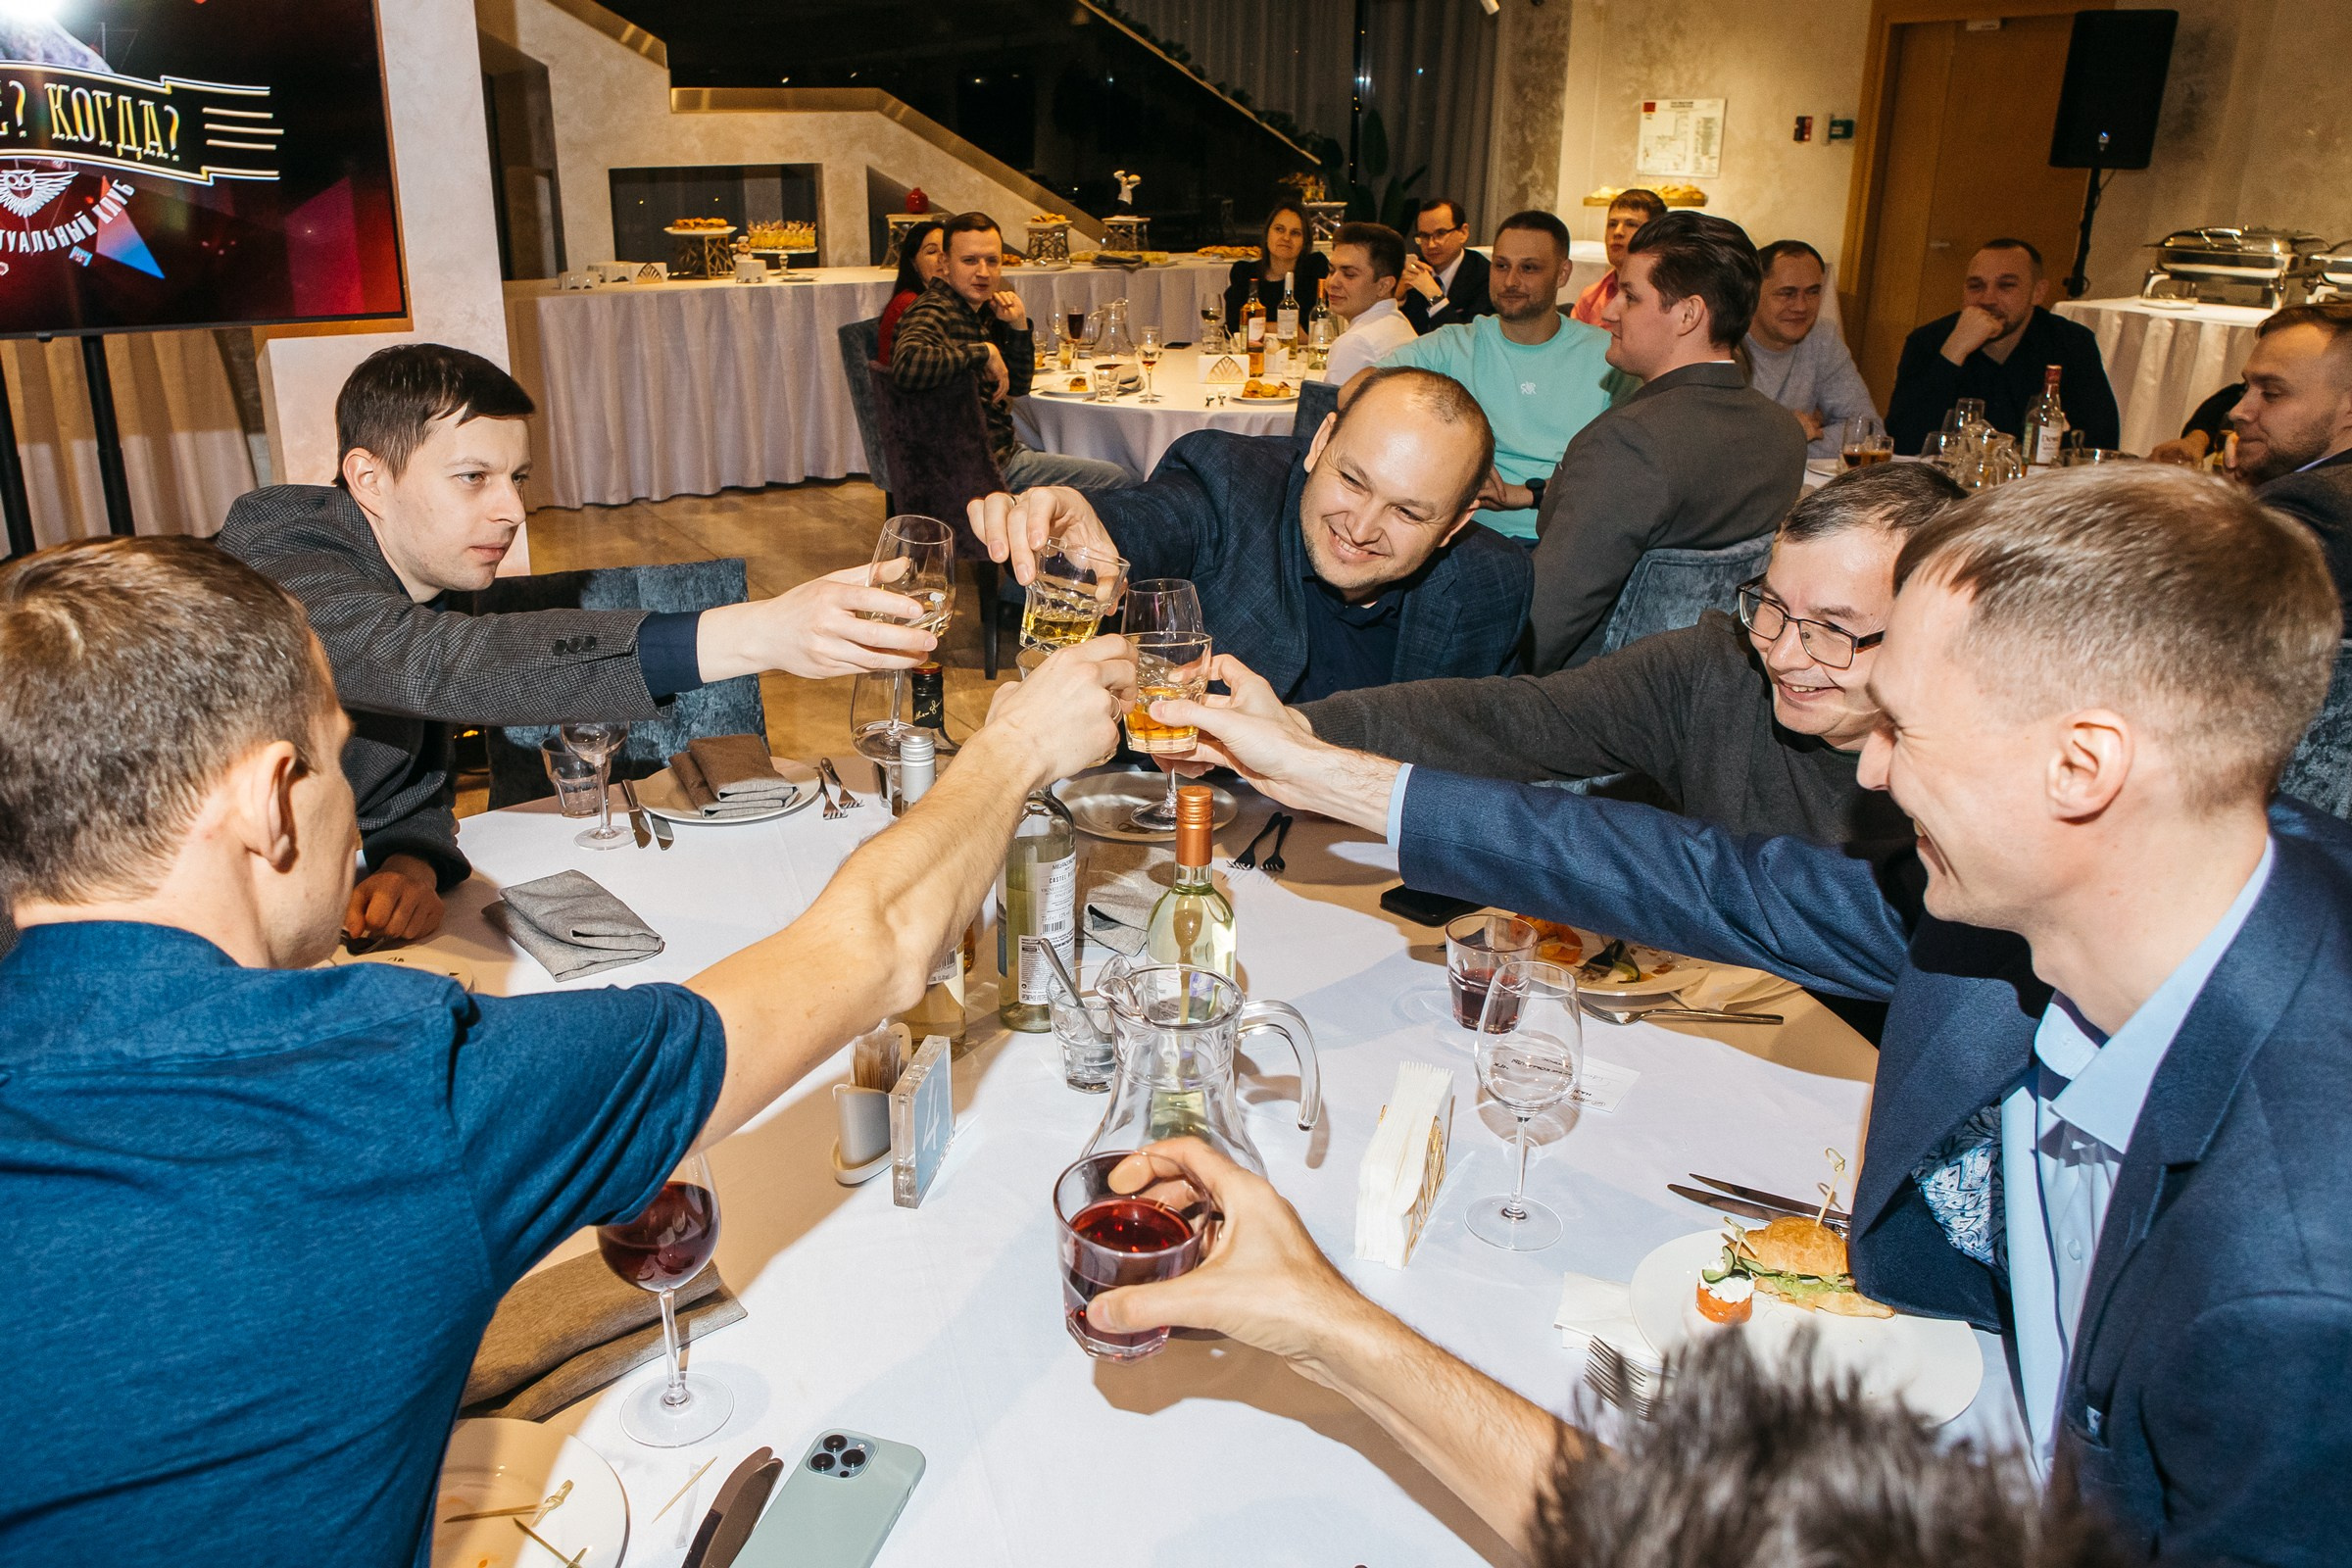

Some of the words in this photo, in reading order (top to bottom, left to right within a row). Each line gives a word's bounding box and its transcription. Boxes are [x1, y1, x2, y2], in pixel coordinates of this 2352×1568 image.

[43, 82, 180, 162] КОГДА?
[91, 178, 135, 224] КЛУБ
[922, 1076, 940, 1151] 4
